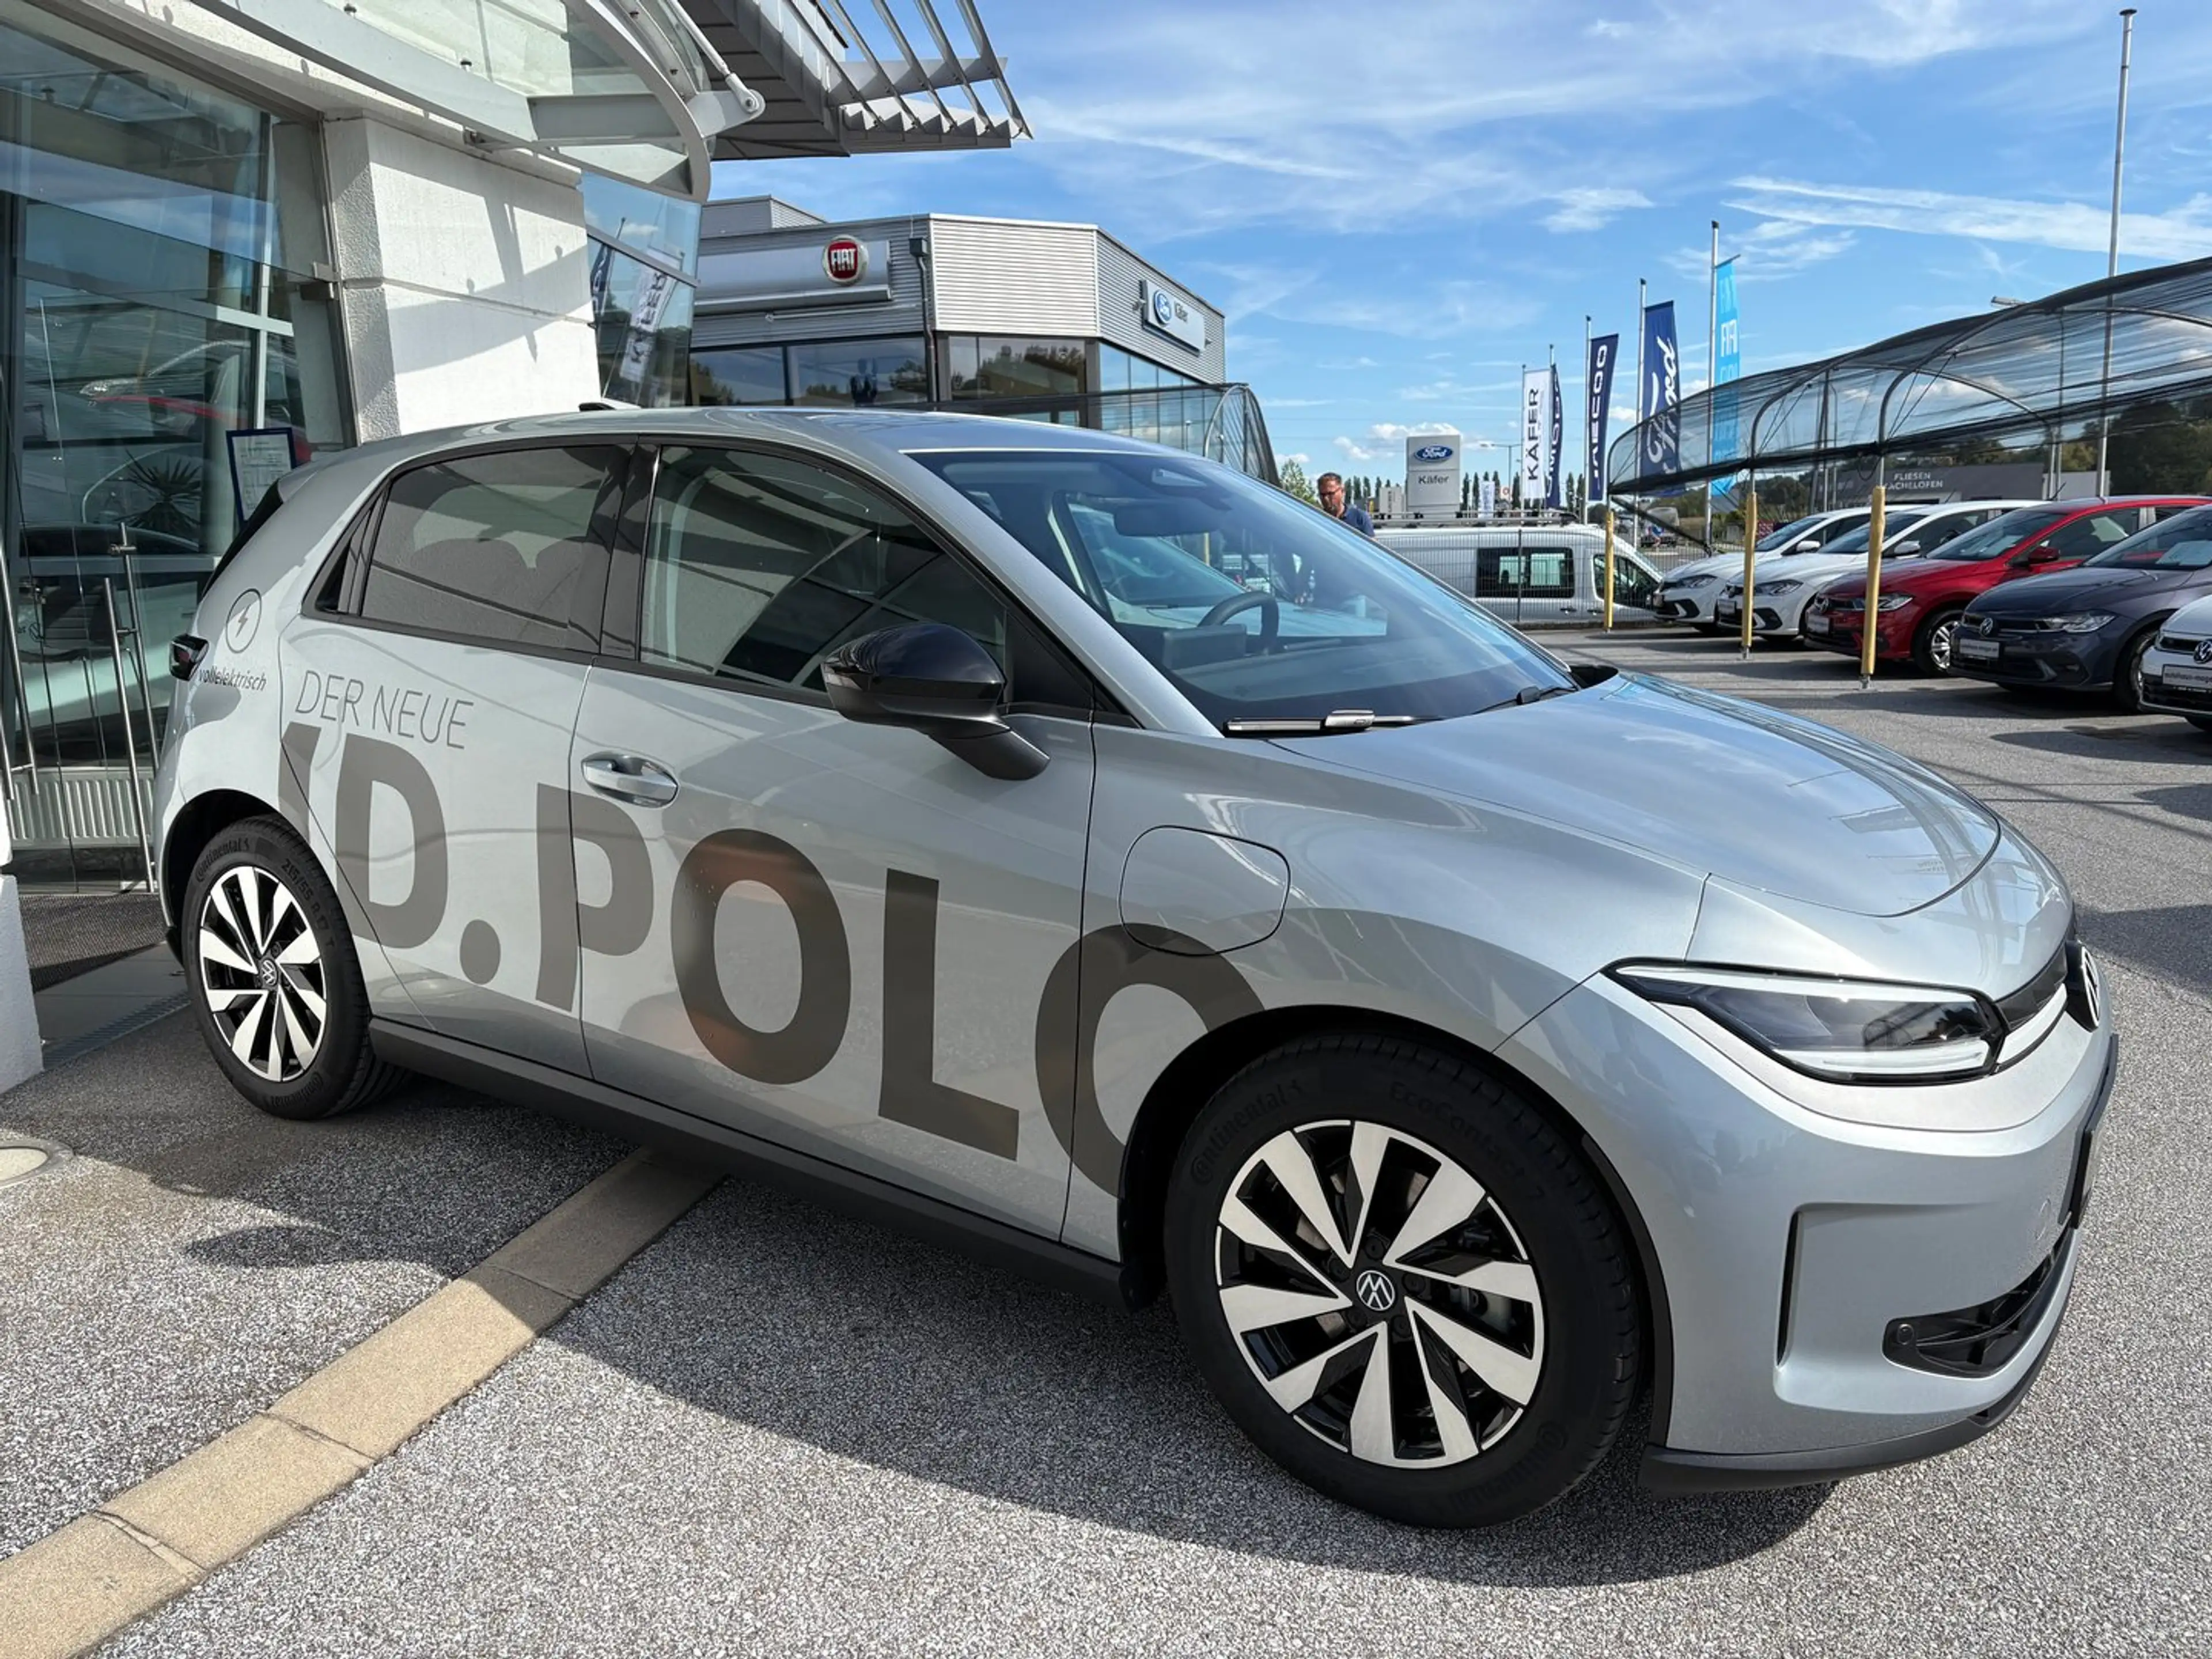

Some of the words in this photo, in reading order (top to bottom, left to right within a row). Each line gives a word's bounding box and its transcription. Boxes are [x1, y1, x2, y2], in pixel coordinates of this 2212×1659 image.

[831, 248, 856, 271] FIAT
[1526, 388, 1539, 480] KÄFER
[1418, 475, 1449, 485] Käfer
[1894, 472, 1931, 481] FLIESEN
[295, 670, 365, 726] DER
[372, 685, 474, 749] NEUE
